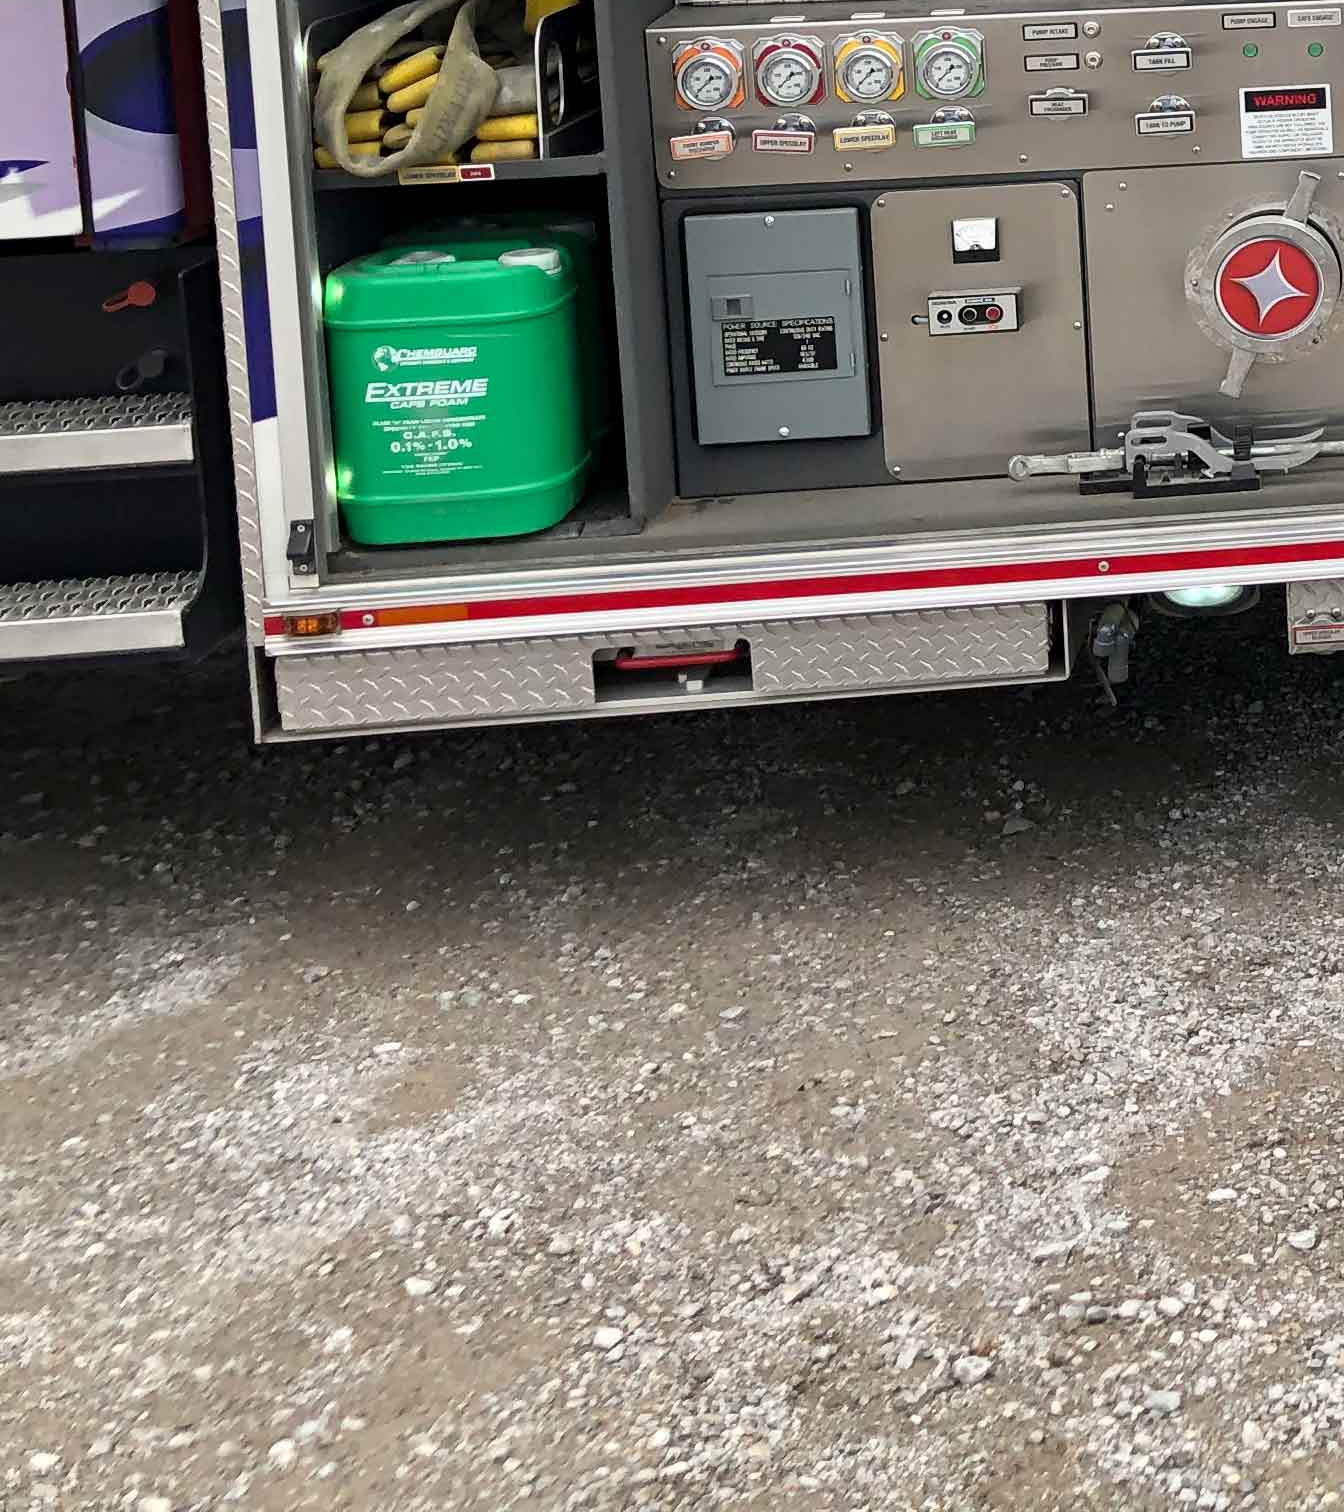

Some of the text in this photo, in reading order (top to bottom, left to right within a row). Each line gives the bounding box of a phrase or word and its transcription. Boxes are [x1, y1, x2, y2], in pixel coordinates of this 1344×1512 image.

[1253, 93, 1318, 107] WARNING
[364, 377, 489, 403] EXTREME
[429, 397, 470, 408] FOAM
